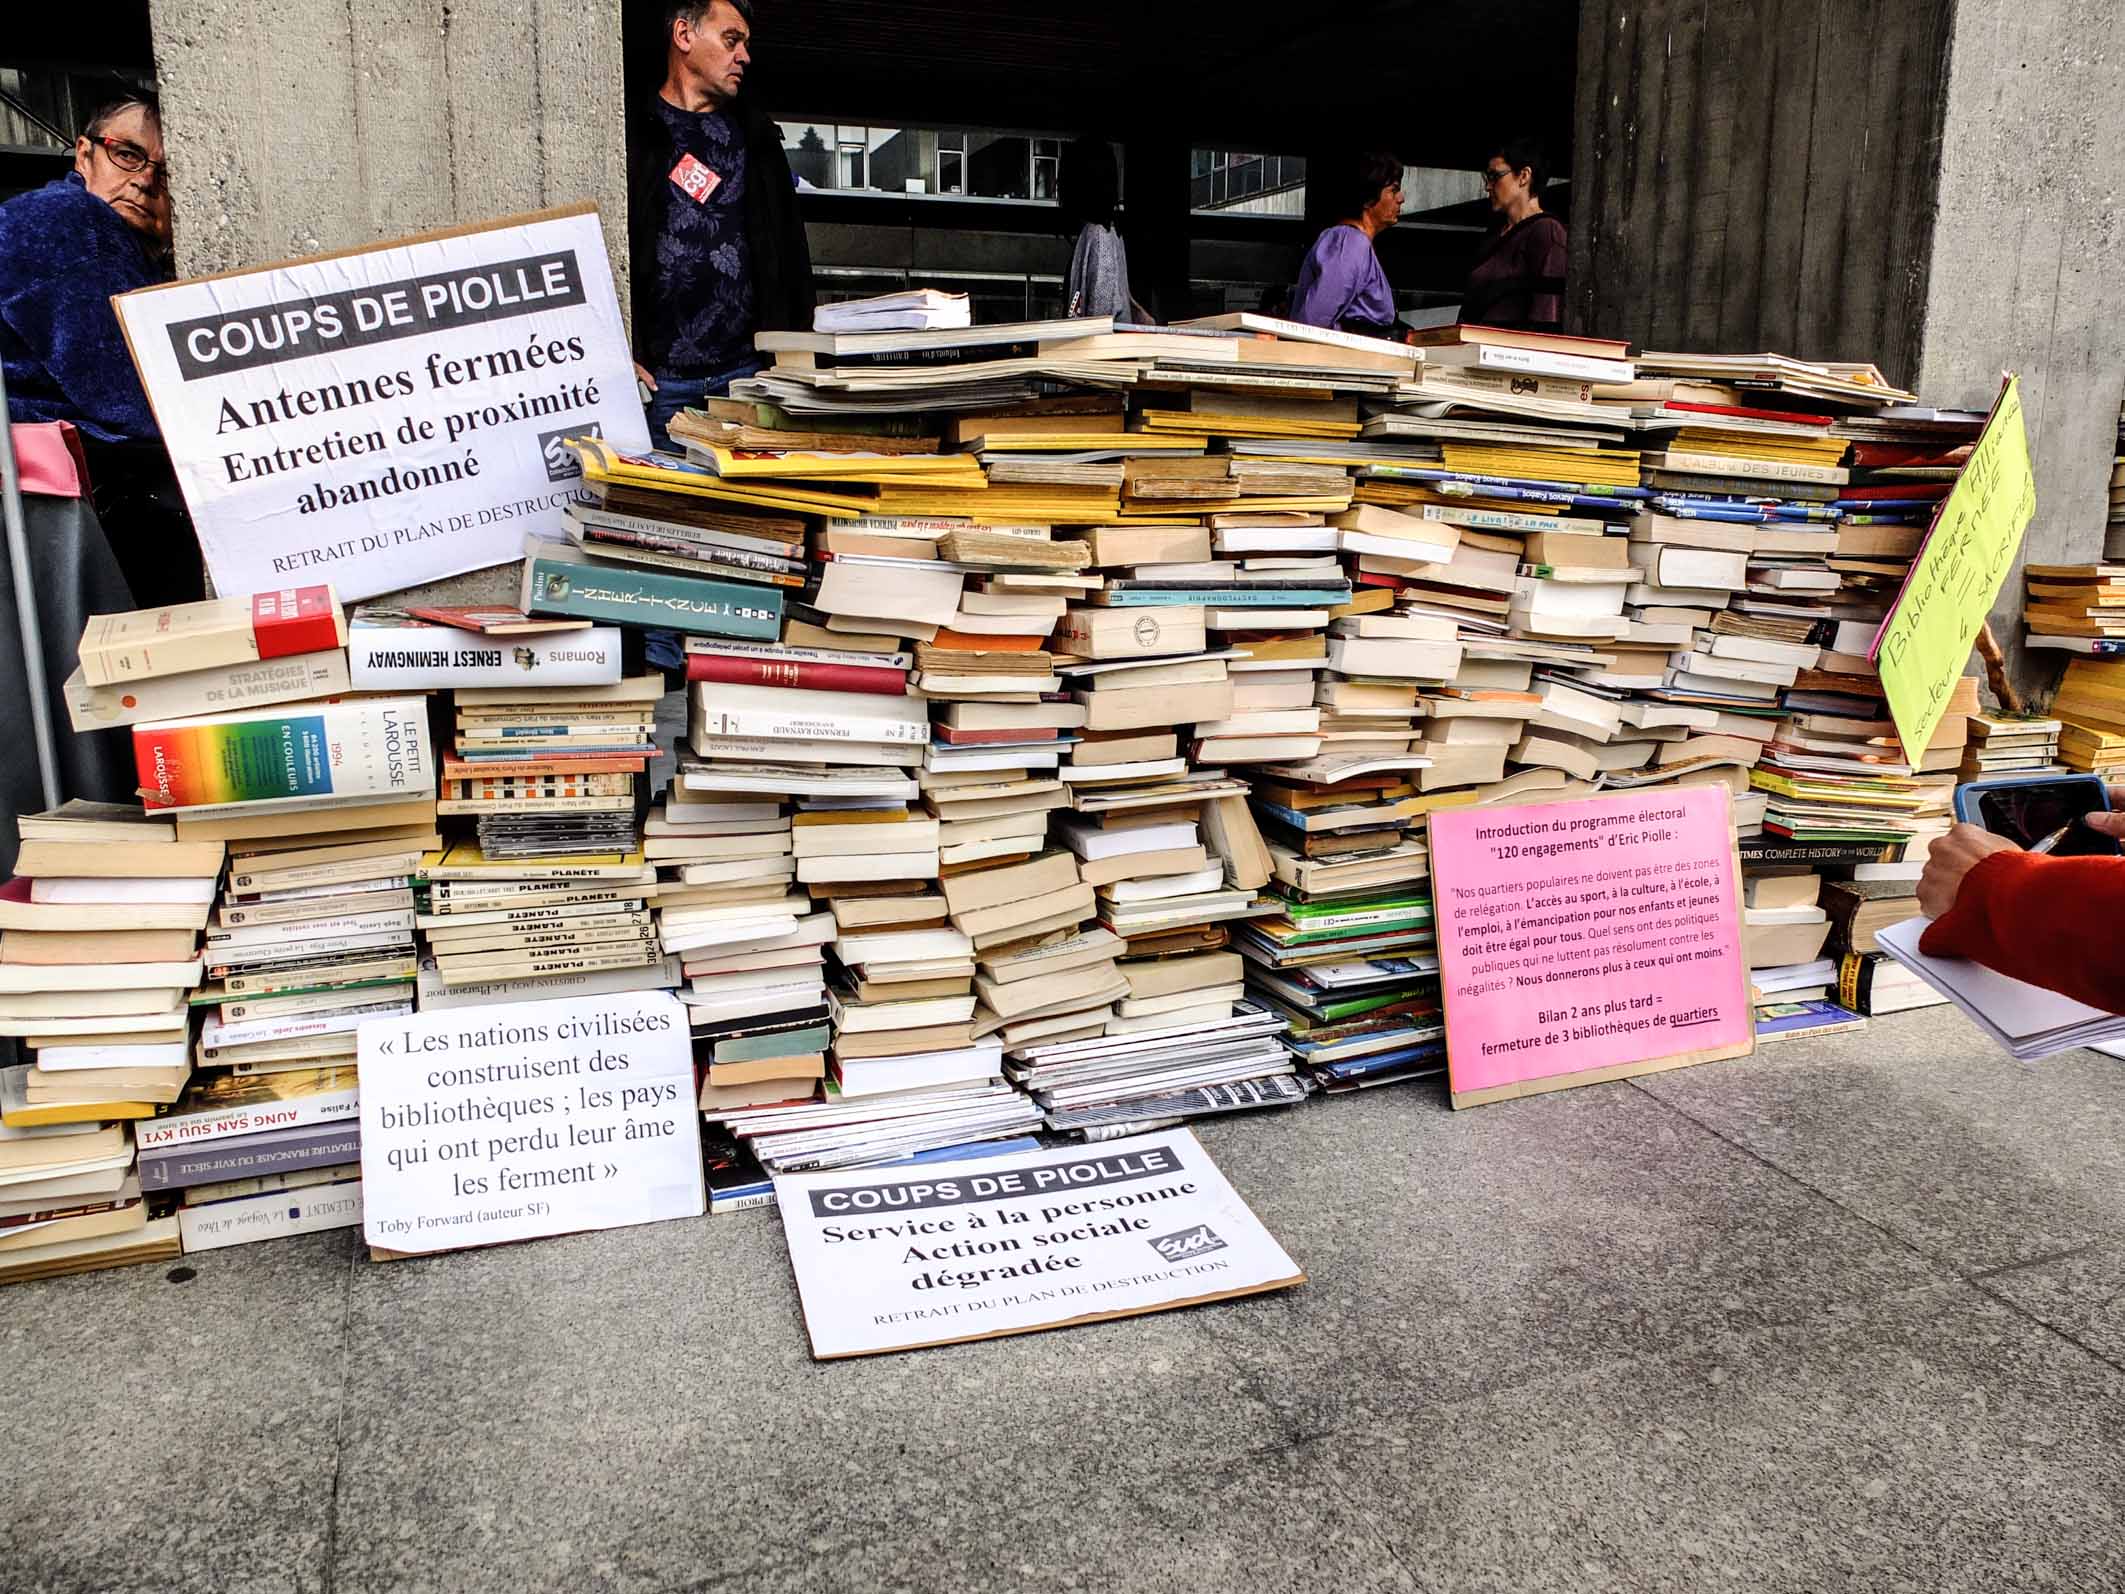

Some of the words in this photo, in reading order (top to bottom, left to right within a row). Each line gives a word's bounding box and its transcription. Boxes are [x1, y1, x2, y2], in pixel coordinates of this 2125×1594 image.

[187, 304, 344, 363] COUPS
[353, 290, 413, 332] DE
[421, 261, 570, 319] PIOLLE
[216, 368, 414, 435] Antennes
[424, 333, 585, 389] fermées
[221, 430, 387, 484] Entretien
[397, 416, 436, 445] de
[443, 377, 601, 443] proximité
[296, 448, 480, 514] abandonné
[272, 540, 356, 573] RETRAIT
[361, 533, 389, 552] DU
[394, 520, 444, 545] PLAN
[448, 514, 474, 532] DE
[478, 487, 601, 525] DESTRUCTIO
[533, 571, 545, 602] Paolini
[367, 650, 450, 669] HEMINGWAY
[452, 650, 502, 668] ERNEST
[549, 649, 606, 665] Romans
[247, 678, 309, 698] MUSIQUE
[280, 724, 292, 741] EN
[403, 720, 417, 737] LE
[282, 740, 299, 792] COULEURS
[331, 742, 343, 767] 1994
[382, 709, 406, 789] LAROUSSE
[405, 737, 421, 775] PETIT
[1476, 822, 1548, 840] Introduction
[1552, 819, 1566, 831] du
[1570, 814, 1635, 832] programme
[1639, 806, 1686, 822] électoral
[1491, 846, 1518, 859] "120
[1522, 835, 1604, 857] engagements"
[1642, 829, 1671, 843] Piolle
[1764, 848, 1807, 860] COMPLETE
[1808, 847, 1841, 859] HISTORY
[1478, 882, 1523, 898] quartiers
[1526, 875, 1578, 891] populaires
[1596, 868, 1632, 881] doivent
[1635, 867, 1651, 880] pas
[1653, 863, 1672, 875] être
[1675, 861, 1691, 872] des
[1694, 858, 1719, 869] zones
[1454, 908, 1466, 918] de
[1565, 895, 1577, 904] au
[1580, 890, 1609, 904] sport,
[1631, 882, 1668, 896] culture,
[1593, 907, 1616, 921] pour
[1619, 905, 1636, 915] nos
[1639, 900, 1675, 913] enfants
[1689, 895, 1719, 909] jeunes
[1462, 944, 1482, 956] doit
[1486, 941, 1506, 953] être
[1509, 938, 1530, 951] égal
[1533, 934, 1557, 949] pour
[1588, 927, 1611, 939] Quel
[1613, 924, 1635, 935] sens
[1637, 921, 1653, 932] ont
[1655, 919, 1672, 929] des
[1674, 912, 1719, 927] politiques
[1472, 959, 1520, 976] publiques
[1522, 956, 1539, 968] qui
[1557, 948, 1591, 962] luttent
[1593, 946, 1610, 959] pas
[1612, 937, 1667, 952] résolument
[1669, 933, 1698, 946] contre
[1701, 931, 1714, 941] les
[1457, 980, 1506, 997] inégalités
[1516, 975, 1543, 987] Nous
[1546, 966, 1600, 982] donnerons
[1602, 963, 1623, 976] plus
[1633, 957, 1656, 969] ceux
[1658, 954, 1674, 967] qui
[1676, 952, 1692, 963] ont
[1538, 1010, 1567, 1024] Bilan
[1571, 1007, 1577, 1019] 2
[1581, 1005, 1600, 1017] ans
[1604, 1000, 1627, 1016] plus
[1630, 994, 1653, 1009] tard
[403, 1031, 449, 1054] Les
[458, 1022, 549, 1049] nations
[557, 1010, 671, 1040] civilisées
[1481, 1036, 1541, 1056] fermeture
[1545, 1032, 1559, 1044] de
[1562, 1030, 1569, 1042] 3
[1573, 1018, 1650, 1040] bibliothèques
[1653, 1014, 1666, 1026] de
[1670, 1007, 1718, 1025] quartiers
[427, 1056, 581, 1088] construisent
[589, 1050, 630, 1073] des
[253, 1110, 298, 1128] AUNG
[319, 1104, 351, 1114] Falise
[381, 1095, 555, 1129] bibliothèques
[580, 1087, 613, 1110] les
[621, 1082, 677, 1111] pays
[143, 1131, 174, 1144] KYI
[178, 1124, 212, 1138] SUU
[216, 1117, 250, 1133] SAN
[387, 1139, 428, 1172] qui
[438, 1137, 480, 1161] ont
[488, 1127, 559, 1162] perdu
[569, 1124, 616, 1147] leur
[625, 1118, 675, 1140] âme
[453, 1173, 489, 1197] les
[499, 1160, 596, 1192] ferment
[823, 1182, 961, 1210] COUPS
[970, 1173, 1026, 1197] DE
[1033, 1151, 1169, 1188] PIOLLE
[377, 1220, 413, 1234] Toby
[417, 1211, 473, 1229] Forward
[477, 1203, 523, 1223] (auteur
[527, 1201, 550, 1217] SF)
[821, 1219, 957, 1244] Service
[967, 1212, 987, 1229] à
[997, 1206, 1030, 1226] la
[1041, 1182, 1199, 1224] personne
[903, 1238, 1023, 1264] Action
[1032, 1217, 1152, 1247] sociale
[911, 1253, 1083, 1291] dégradée
[873, 1303, 962, 1325] RETRAIT
[968, 1299, 997, 1311] DU
[1003, 1290, 1056, 1307] PLAN
[1060, 1285, 1088, 1295] DE
[1092, 1259, 1230, 1293] DESTRUCTION
